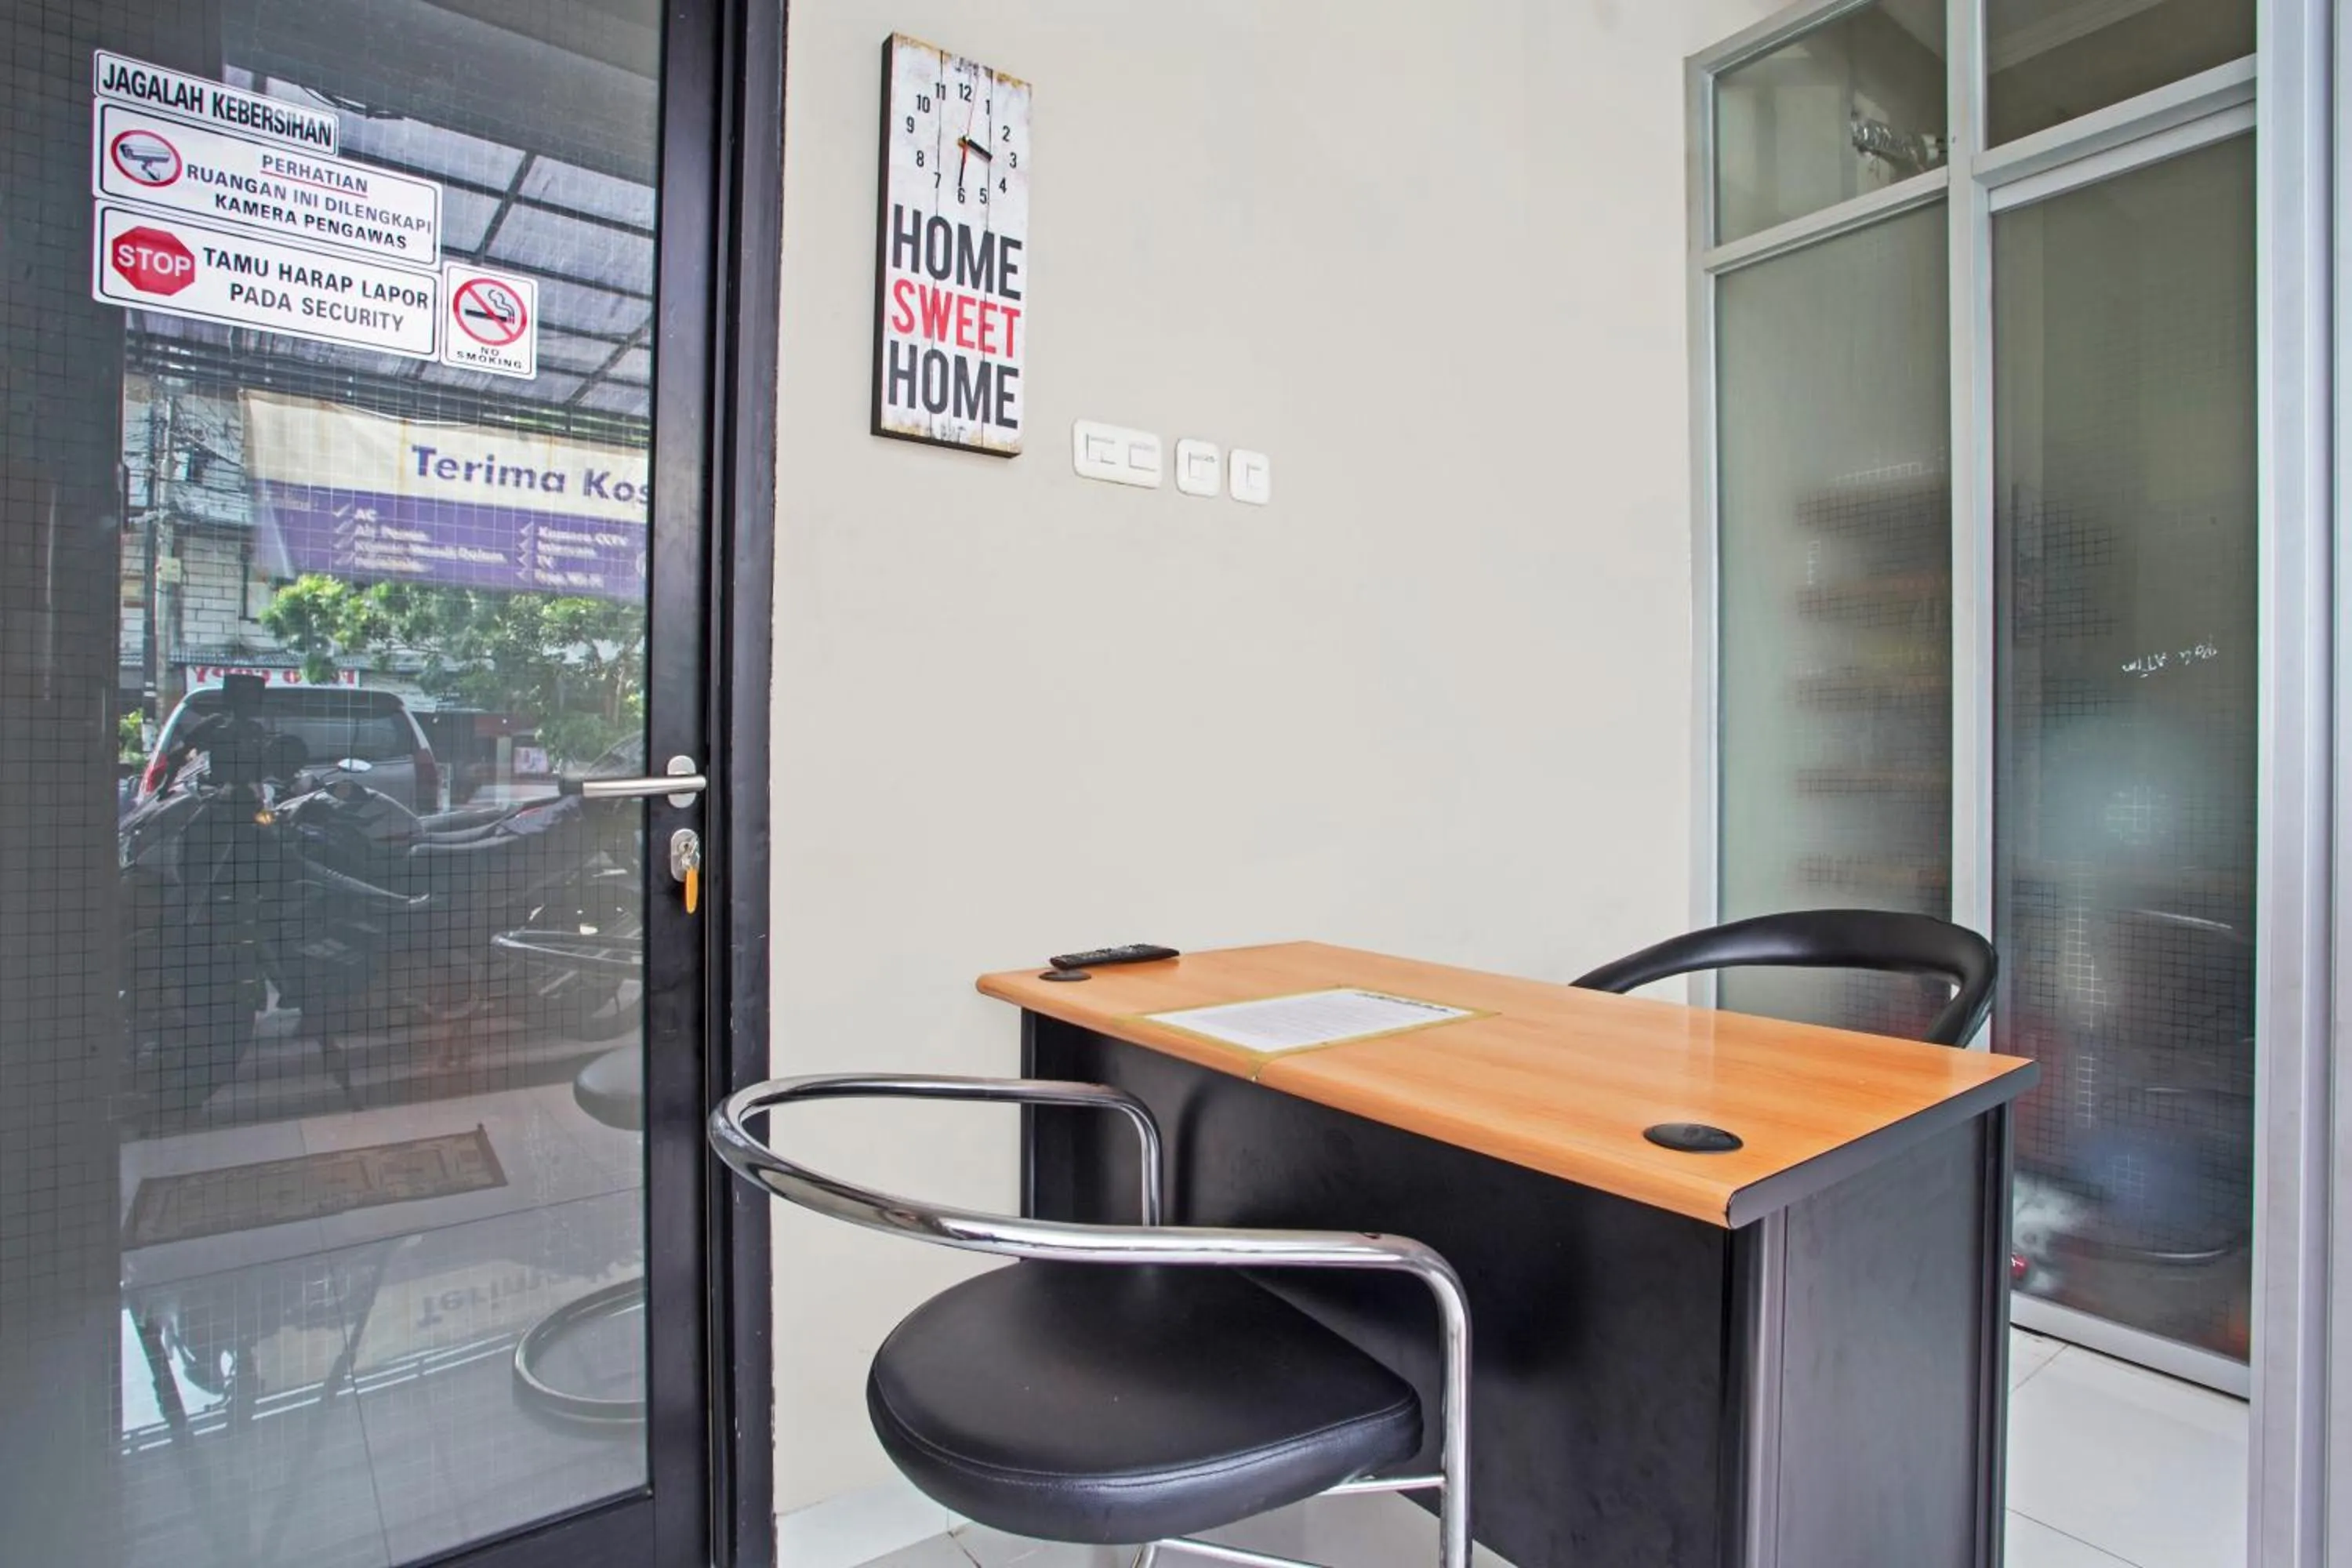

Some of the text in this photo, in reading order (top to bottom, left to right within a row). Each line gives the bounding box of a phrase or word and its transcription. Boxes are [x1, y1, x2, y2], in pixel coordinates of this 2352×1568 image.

[935, 82, 946, 101] 11
[958, 82, 972, 103] 12
[103, 64, 332, 147] JAGALAH KEBERSIHAN
[916, 93, 931, 114] 10
[985, 99, 991, 116] 1
[906, 115, 916, 134] 9
[1002, 125, 1011, 143] 2
[916, 150, 925, 168] 8
[1008, 151, 1018, 169] 3
[262, 154, 368, 194] PERHATIAN
[933, 172, 942, 189] 7
[998, 176, 1007, 194] 4
[187, 164, 431, 234] RUANGAN INI DILENGKAPI
[956, 187, 966, 205] 6
[979, 187, 989, 205] 5
[215, 194, 408, 249] KAMERA PENGAWAS
[118, 244, 192, 277] STOP
[891, 203, 1023, 302] HOME
[202, 246, 430, 310] TAMU HARAP LAPOR
[229, 282, 405, 332] PADA SECURITY
[891, 278, 1022, 359] SWEET
[456, 350, 522, 369] SMOKING
[481, 346, 499, 357] NO
[887, 339, 1019, 430] HOME
[411, 444, 566, 494] Terima
